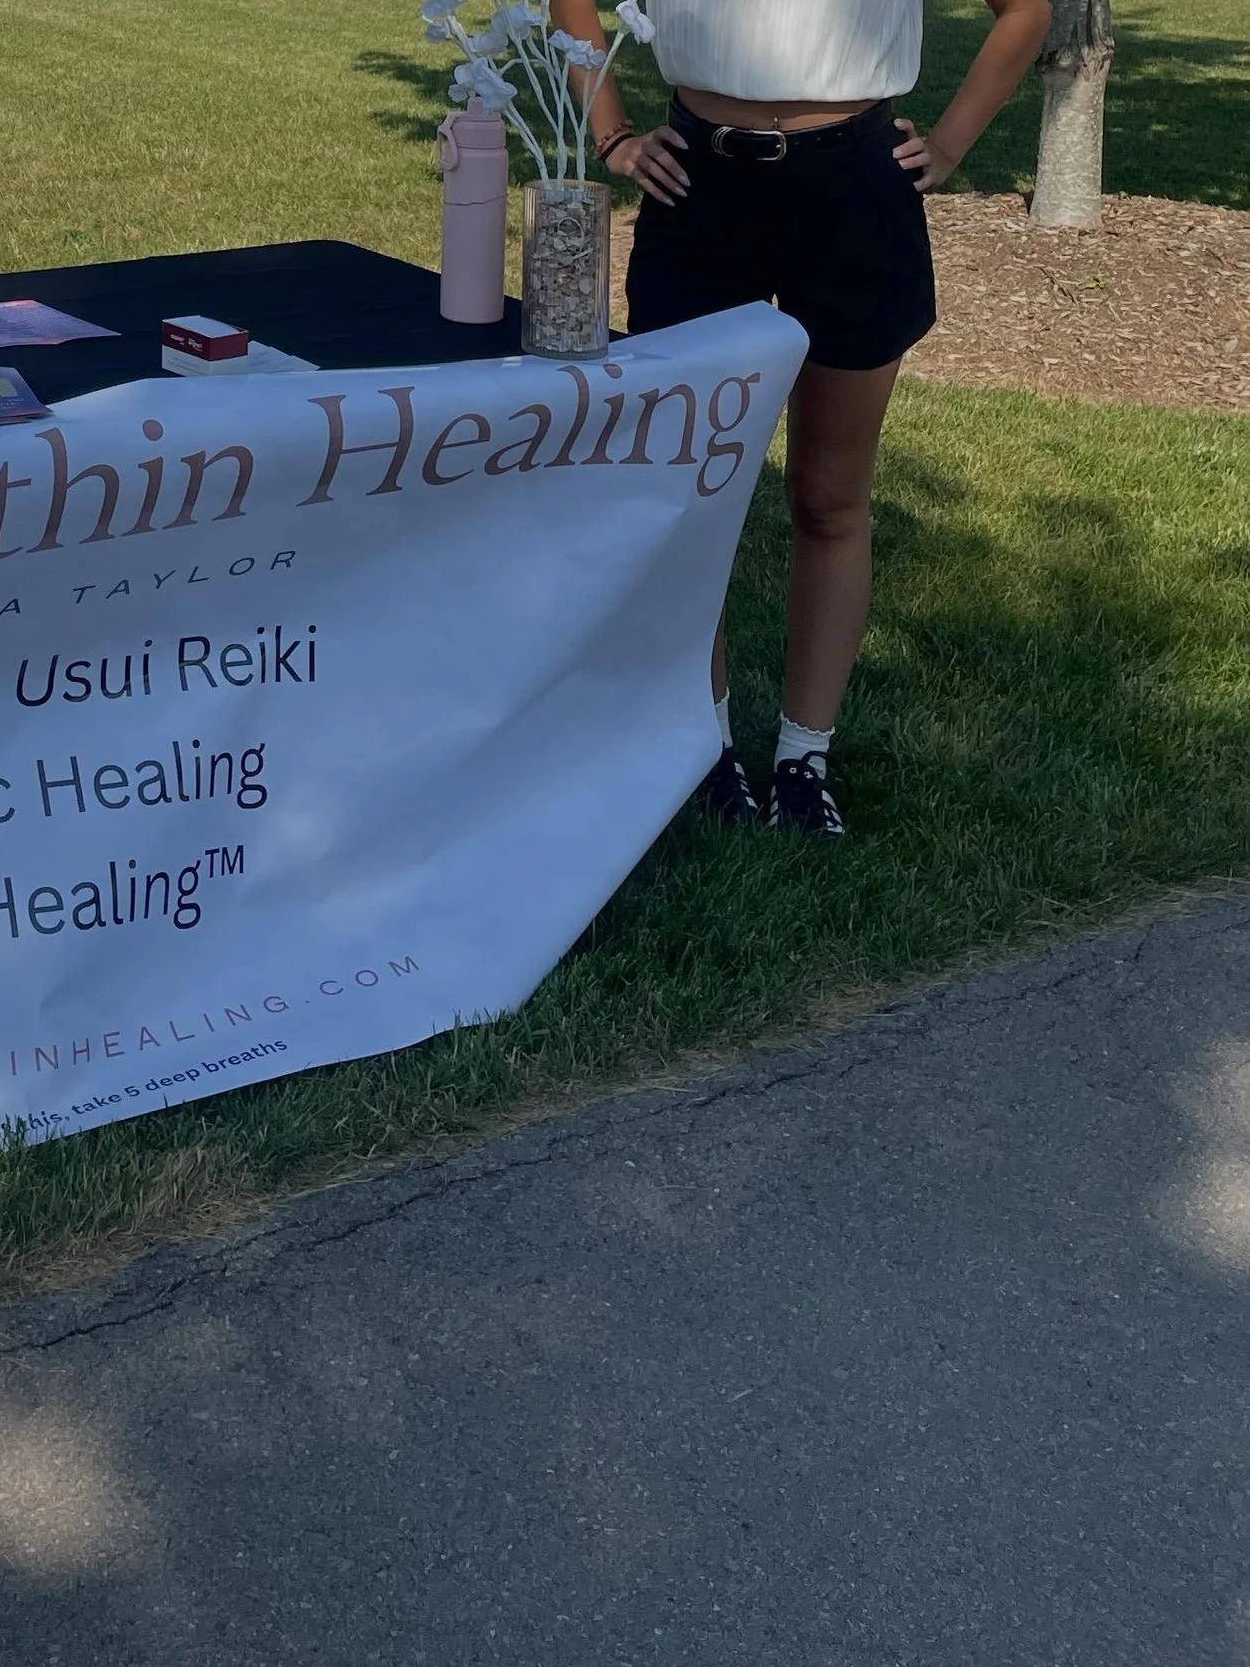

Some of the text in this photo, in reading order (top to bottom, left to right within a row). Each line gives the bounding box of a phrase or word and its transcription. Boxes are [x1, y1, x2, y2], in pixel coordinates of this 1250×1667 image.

[297, 364, 761, 508] Healing
[72, 549, 298, 605] TAYLOR
[15, 639, 154, 708] Usui
[178, 625, 318, 693] Reiki
[36, 738, 270, 817] Healing
[18, 1110, 72, 1131] his,
[71, 1093, 122, 1116] take
[124, 1086, 141, 1099] 5
[145, 1068, 201, 1092] deep
[202, 1039, 288, 1074] breaths
